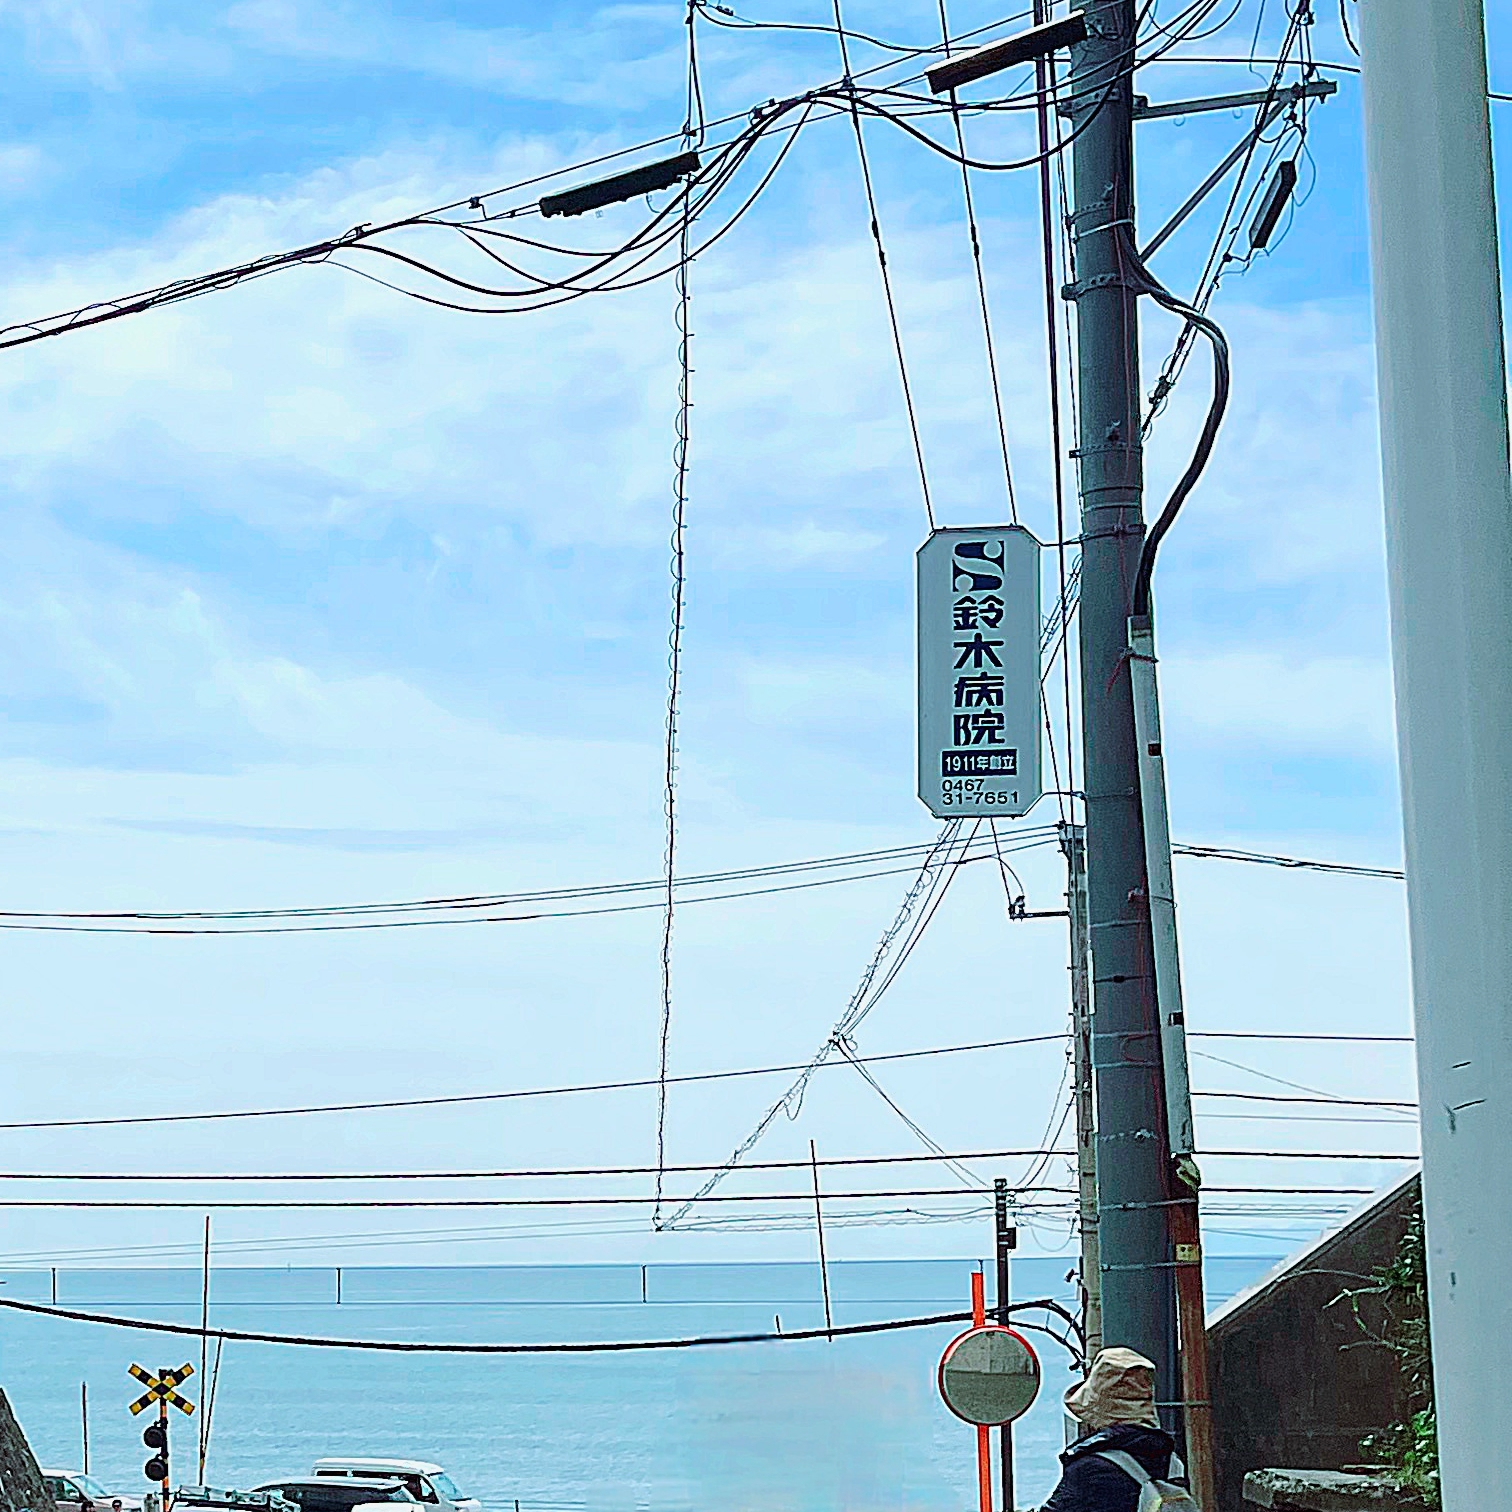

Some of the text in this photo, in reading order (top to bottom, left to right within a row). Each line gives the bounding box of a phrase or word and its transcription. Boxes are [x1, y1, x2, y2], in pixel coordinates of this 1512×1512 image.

[953, 594, 1005, 746] 鈴木病院
[942, 779, 985, 792] 0467
[942, 791, 1018, 805] 31-7651
